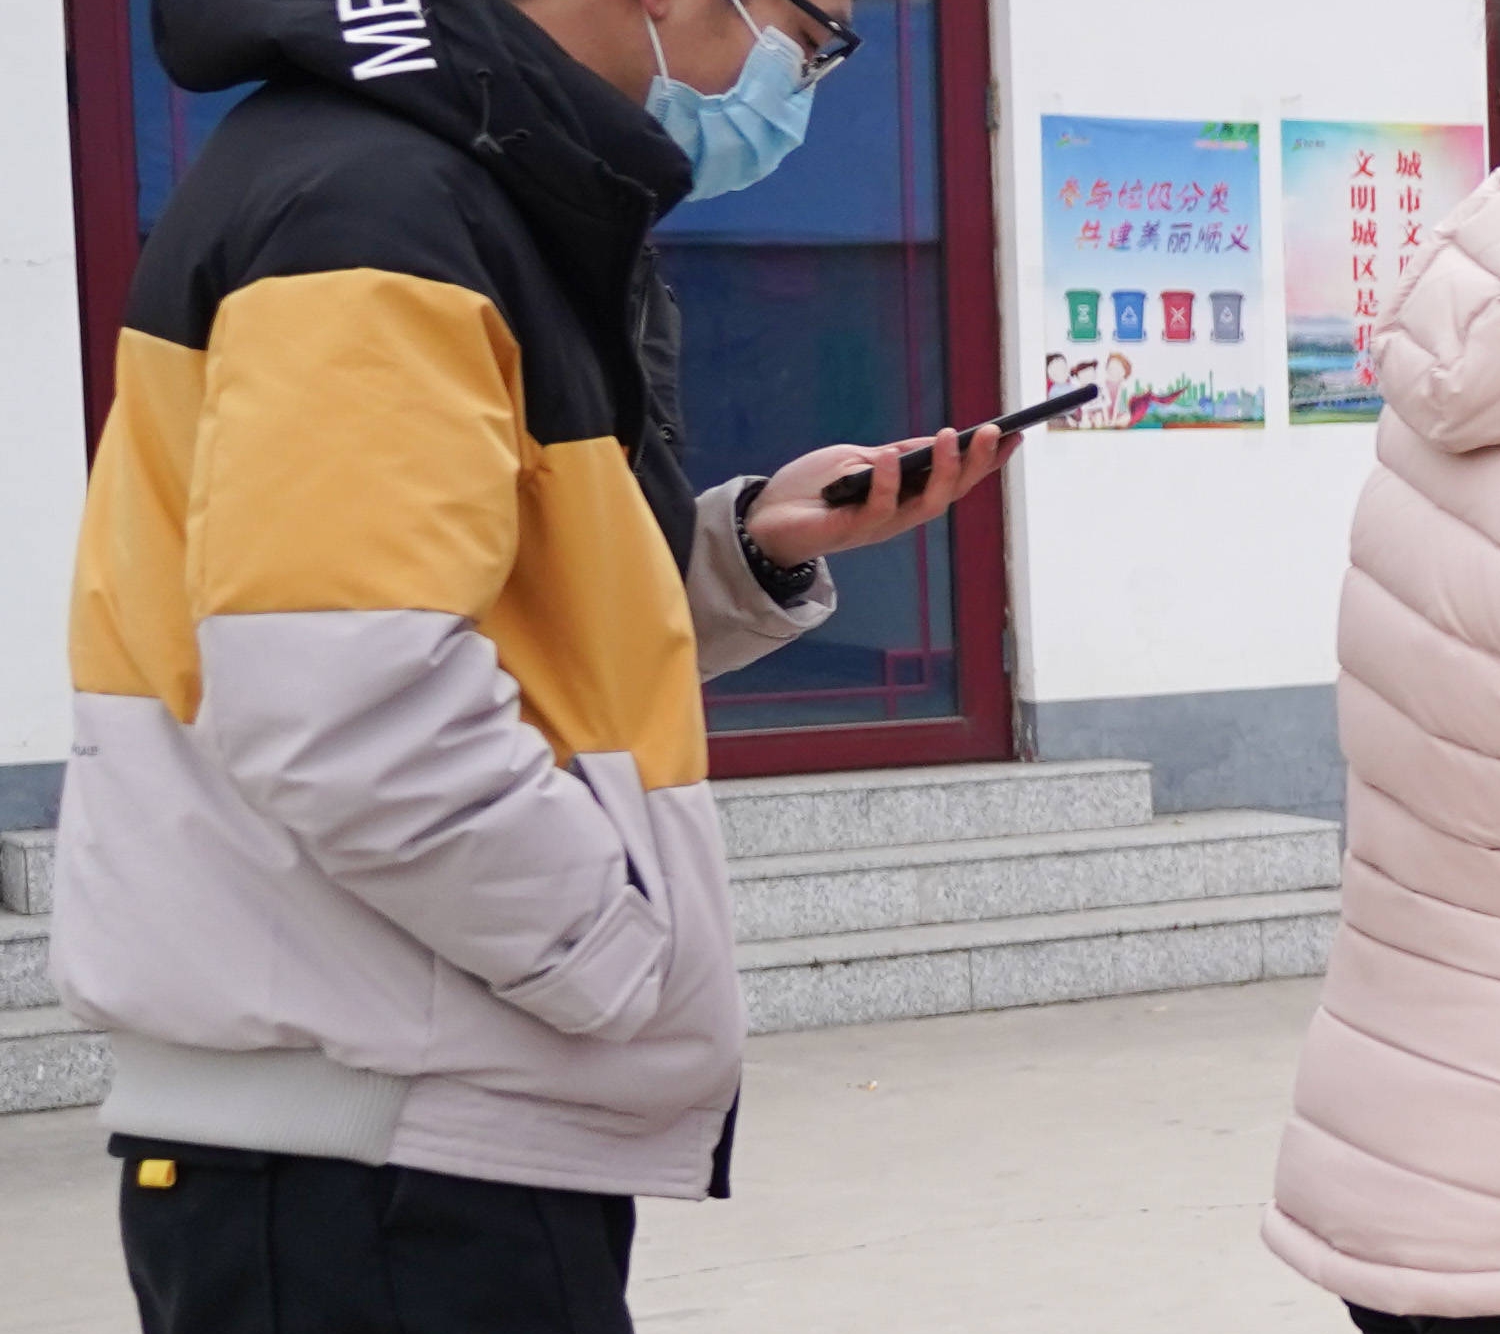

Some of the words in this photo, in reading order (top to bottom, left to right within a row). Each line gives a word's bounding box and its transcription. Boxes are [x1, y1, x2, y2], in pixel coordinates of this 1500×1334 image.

[1058, 175, 1230, 214] 参与垃圾分类
[1396, 148, 1423, 276] 城市文
[1074, 219, 1250, 254] 共建美丽顺义
